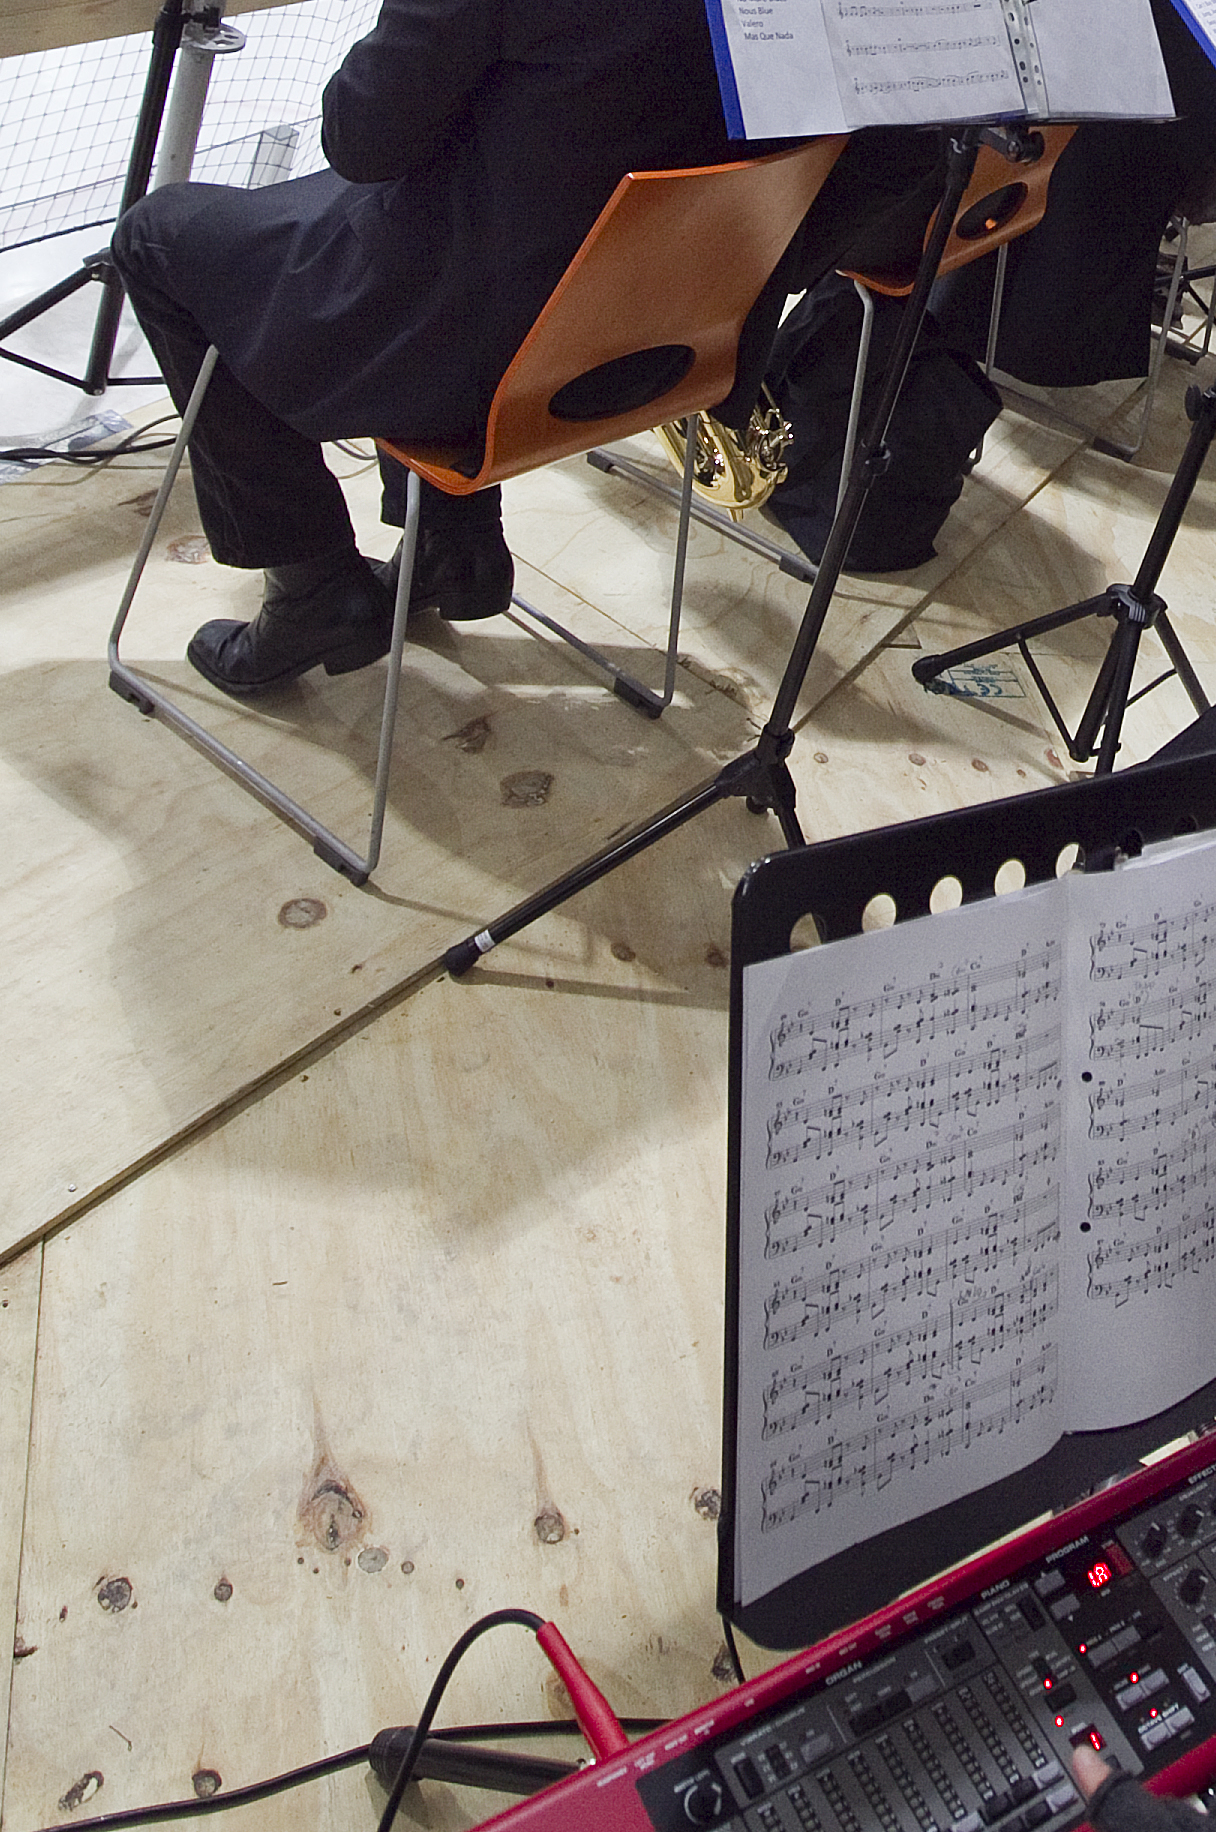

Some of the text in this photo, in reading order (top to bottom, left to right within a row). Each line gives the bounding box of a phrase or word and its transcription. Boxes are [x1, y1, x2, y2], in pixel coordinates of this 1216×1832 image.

[744, 31, 793, 40] Mas Que Nada
[1045, 1535, 1090, 1564] PROGRAM
[980, 1579, 1010, 1600] PIANO
[825, 1660, 862, 1686] ORGAN
